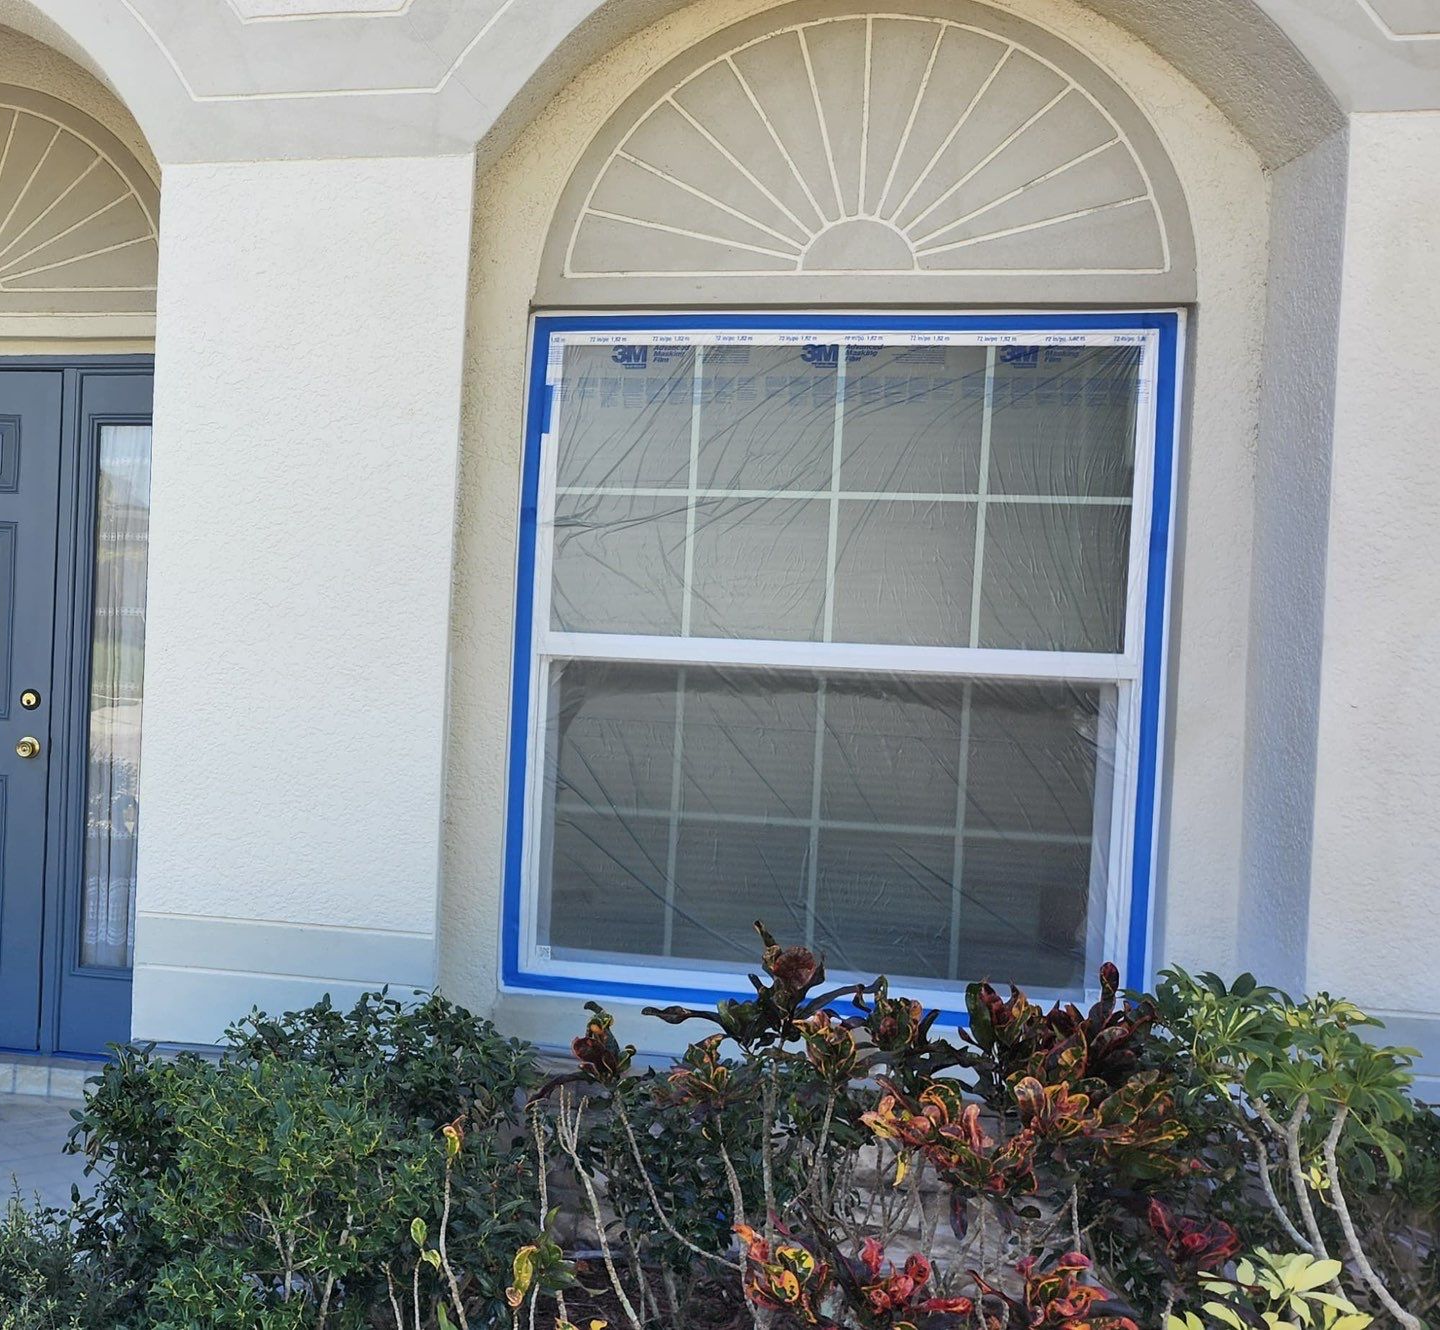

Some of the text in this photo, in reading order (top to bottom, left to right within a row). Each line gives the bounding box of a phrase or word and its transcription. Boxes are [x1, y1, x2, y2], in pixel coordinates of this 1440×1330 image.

[611, 345, 647, 363] 3M
[800, 344, 839, 363] 3M
[1000, 345, 1040, 362] 3M
